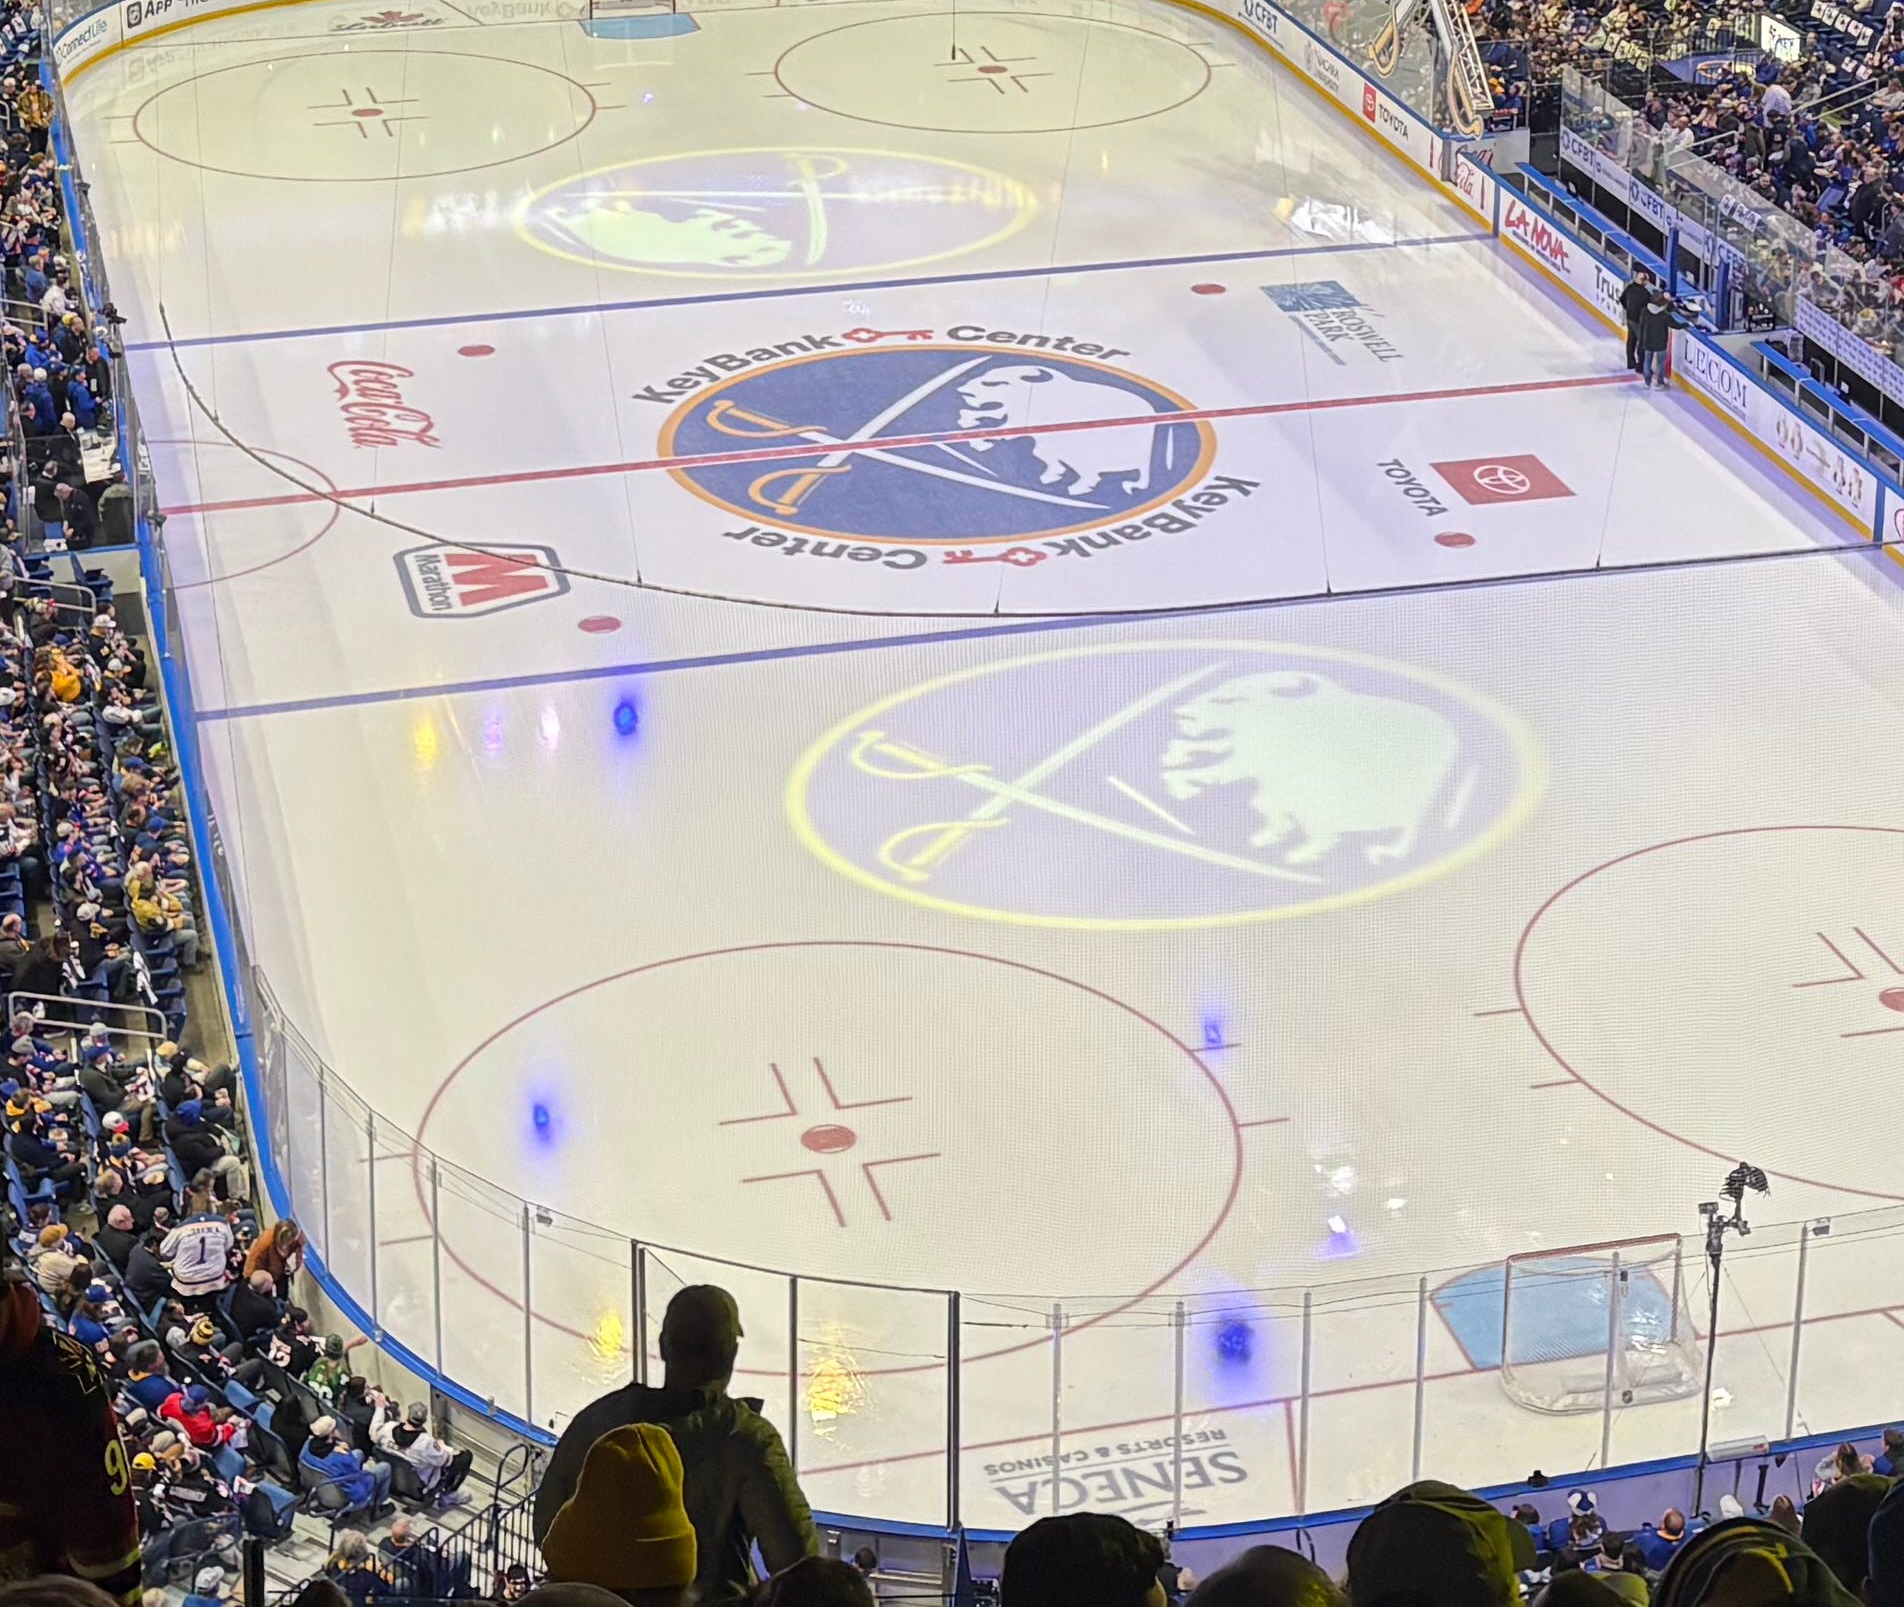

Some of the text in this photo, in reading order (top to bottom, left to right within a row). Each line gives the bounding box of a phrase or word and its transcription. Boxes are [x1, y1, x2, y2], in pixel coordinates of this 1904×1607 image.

[1378, 103, 1409, 140] TOYOTA
[1504, 198, 1529, 232] LA
[1531, 217, 1570, 265] NOVA
[1303, 309, 1353, 343] PARK
[1330, 306, 1404, 363] ROSWELL
[631, 324, 1133, 405] KeyBank Center
[1684, 337, 1747, 408] LECOM
[1377, 458, 1449, 516] TOYOTA
[1049, 474, 1261, 559] KeyBank
[723, 522, 928, 570] Center
[413, 553, 453, 612] Marathon
[983, 1429, 1227, 1476] RESORTS & CASINOS
[995, 1451, 1248, 1515] SENECA
